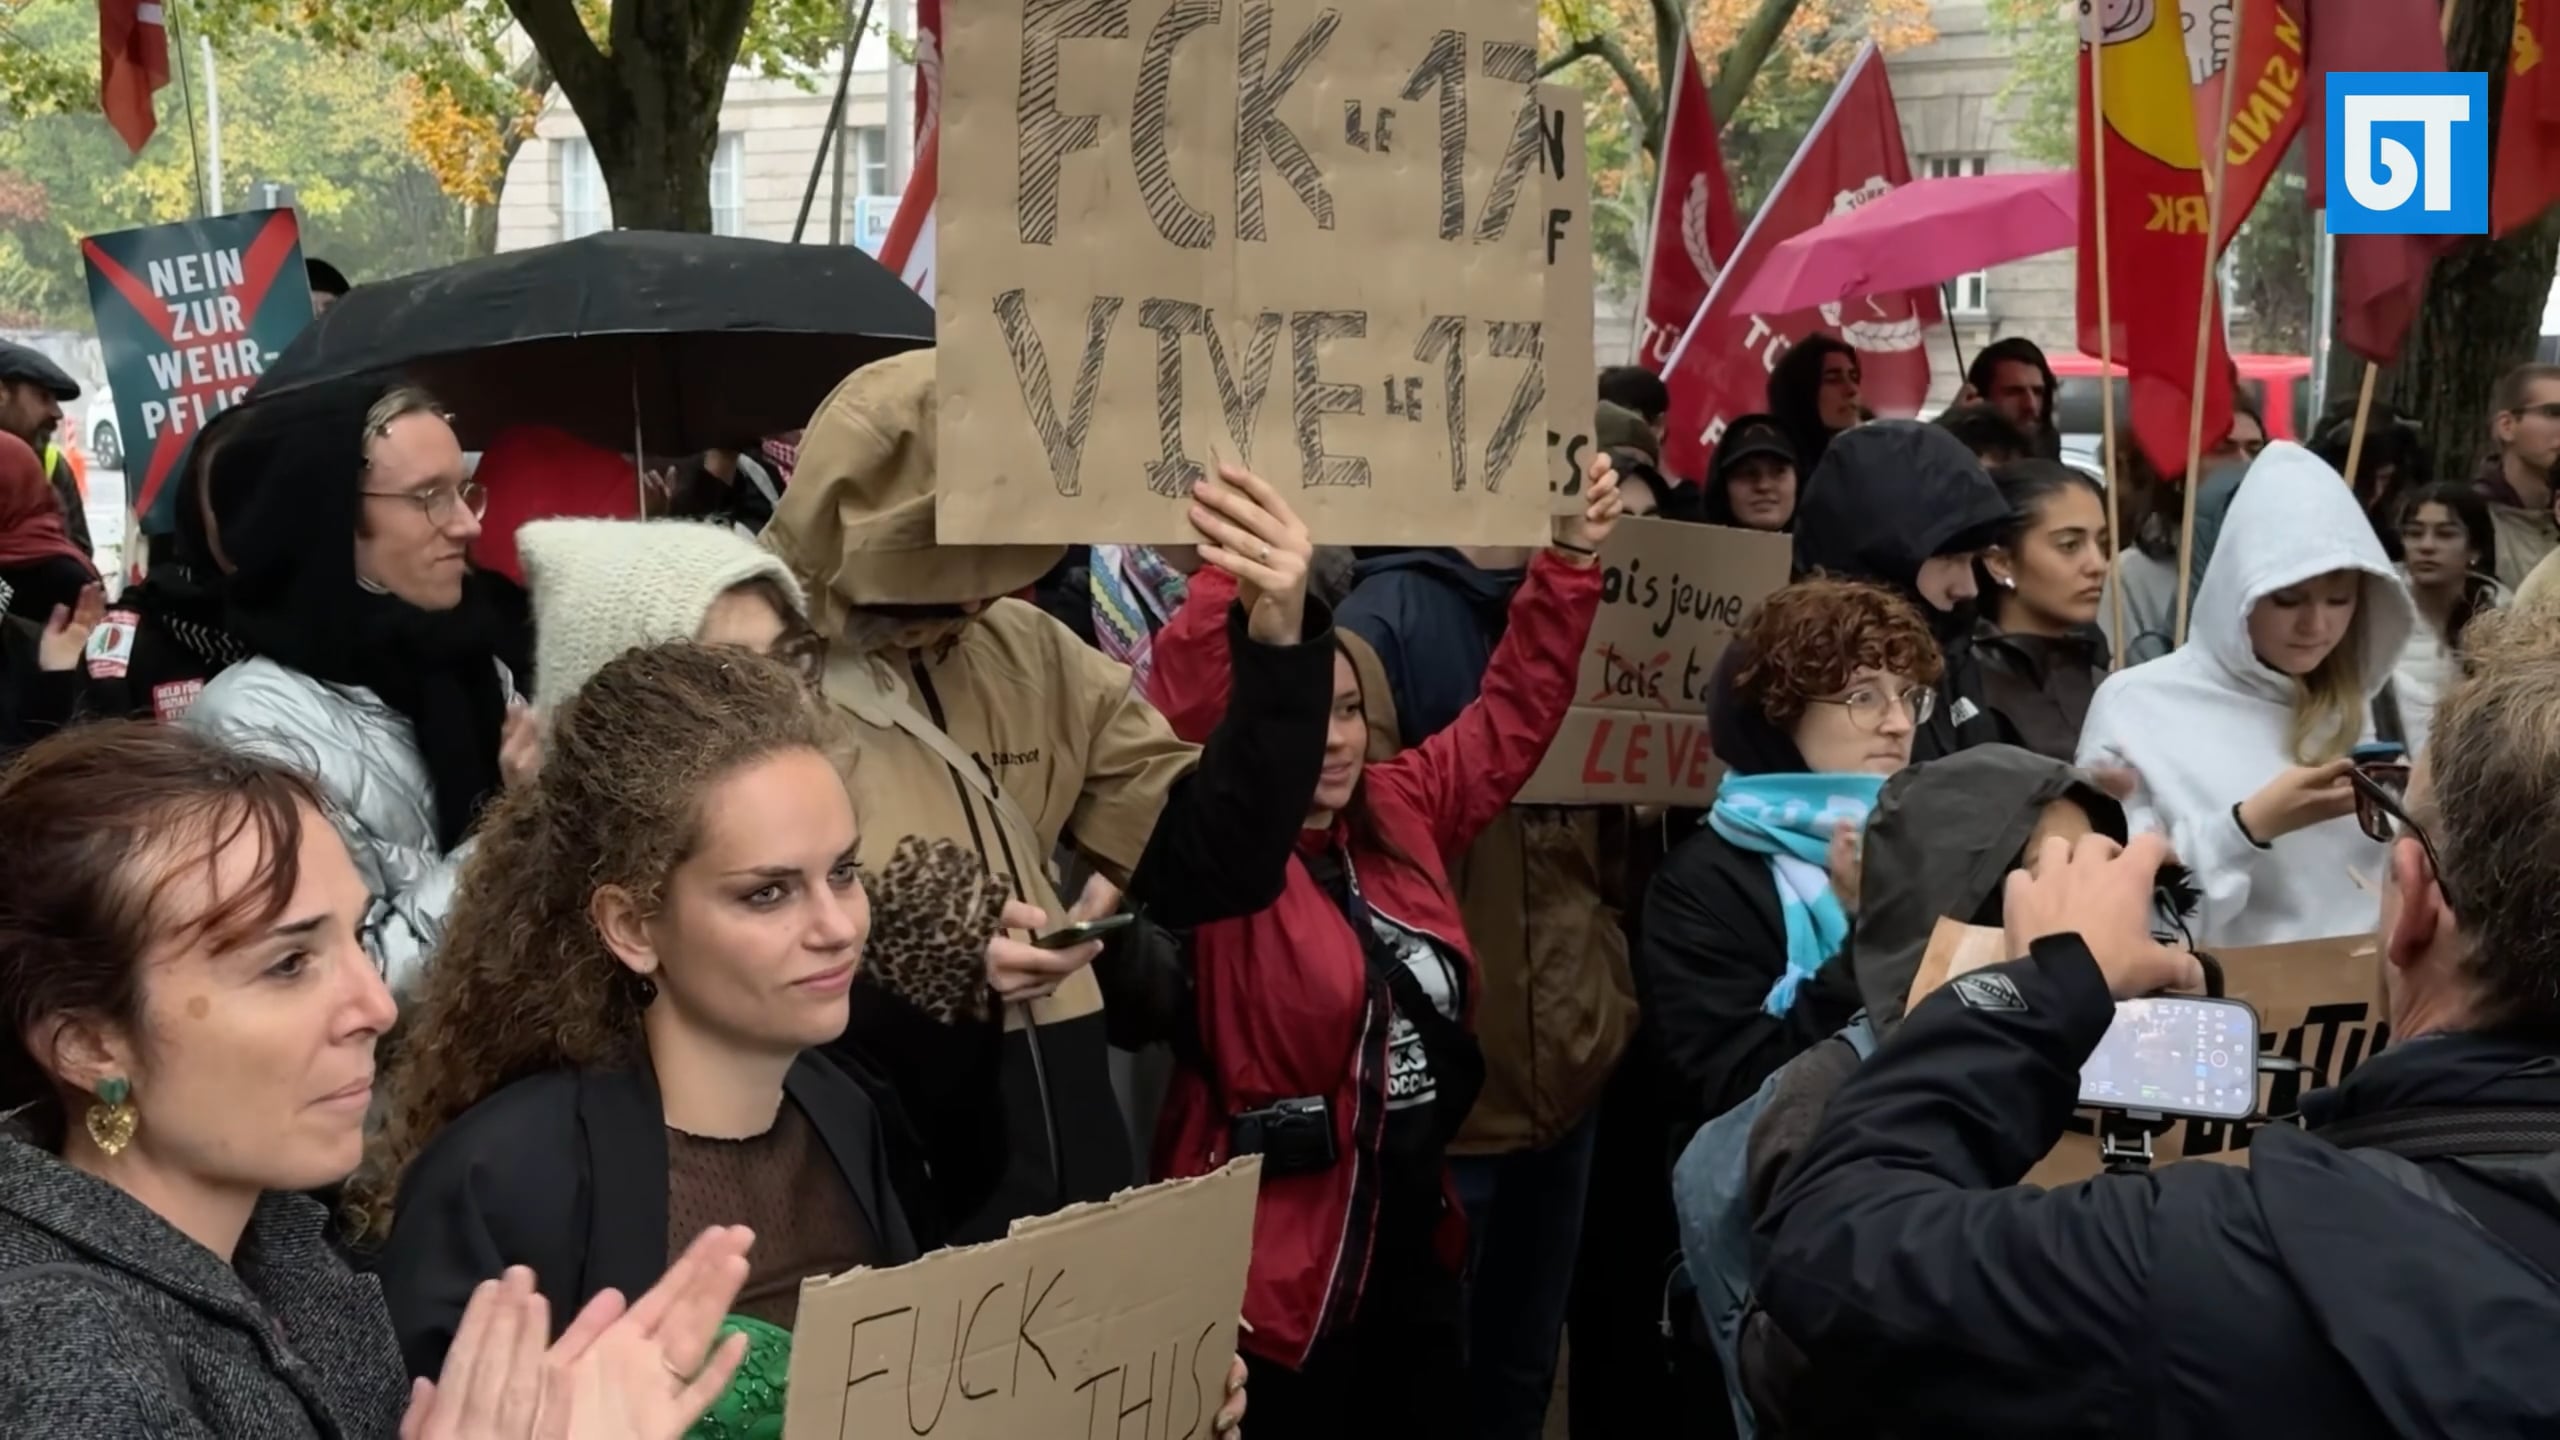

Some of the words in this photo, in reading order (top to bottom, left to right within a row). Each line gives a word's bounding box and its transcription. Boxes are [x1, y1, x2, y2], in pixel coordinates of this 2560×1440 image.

[1016, 0, 1342, 249] FCK
[1345, 100, 1397, 153] LE
[1402, 30, 1540, 244] 17
[1539, 104, 1564, 181] N
[148, 248, 244, 298] NEIN
[167, 295, 245, 342] ZUR
[147, 338, 280, 391] WEHR-
[993, 288, 1371, 498] VIVE
[1384, 374, 1423, 422] LE
[1413, 314, 1546, 494] 17
[1602, 558, 1659, 608] ois
[1652, 572, 1743, 639] jeune
[837, 1266, 1066, 1440] FUCK
[1073, 1322, 1216, 1440] THIS
